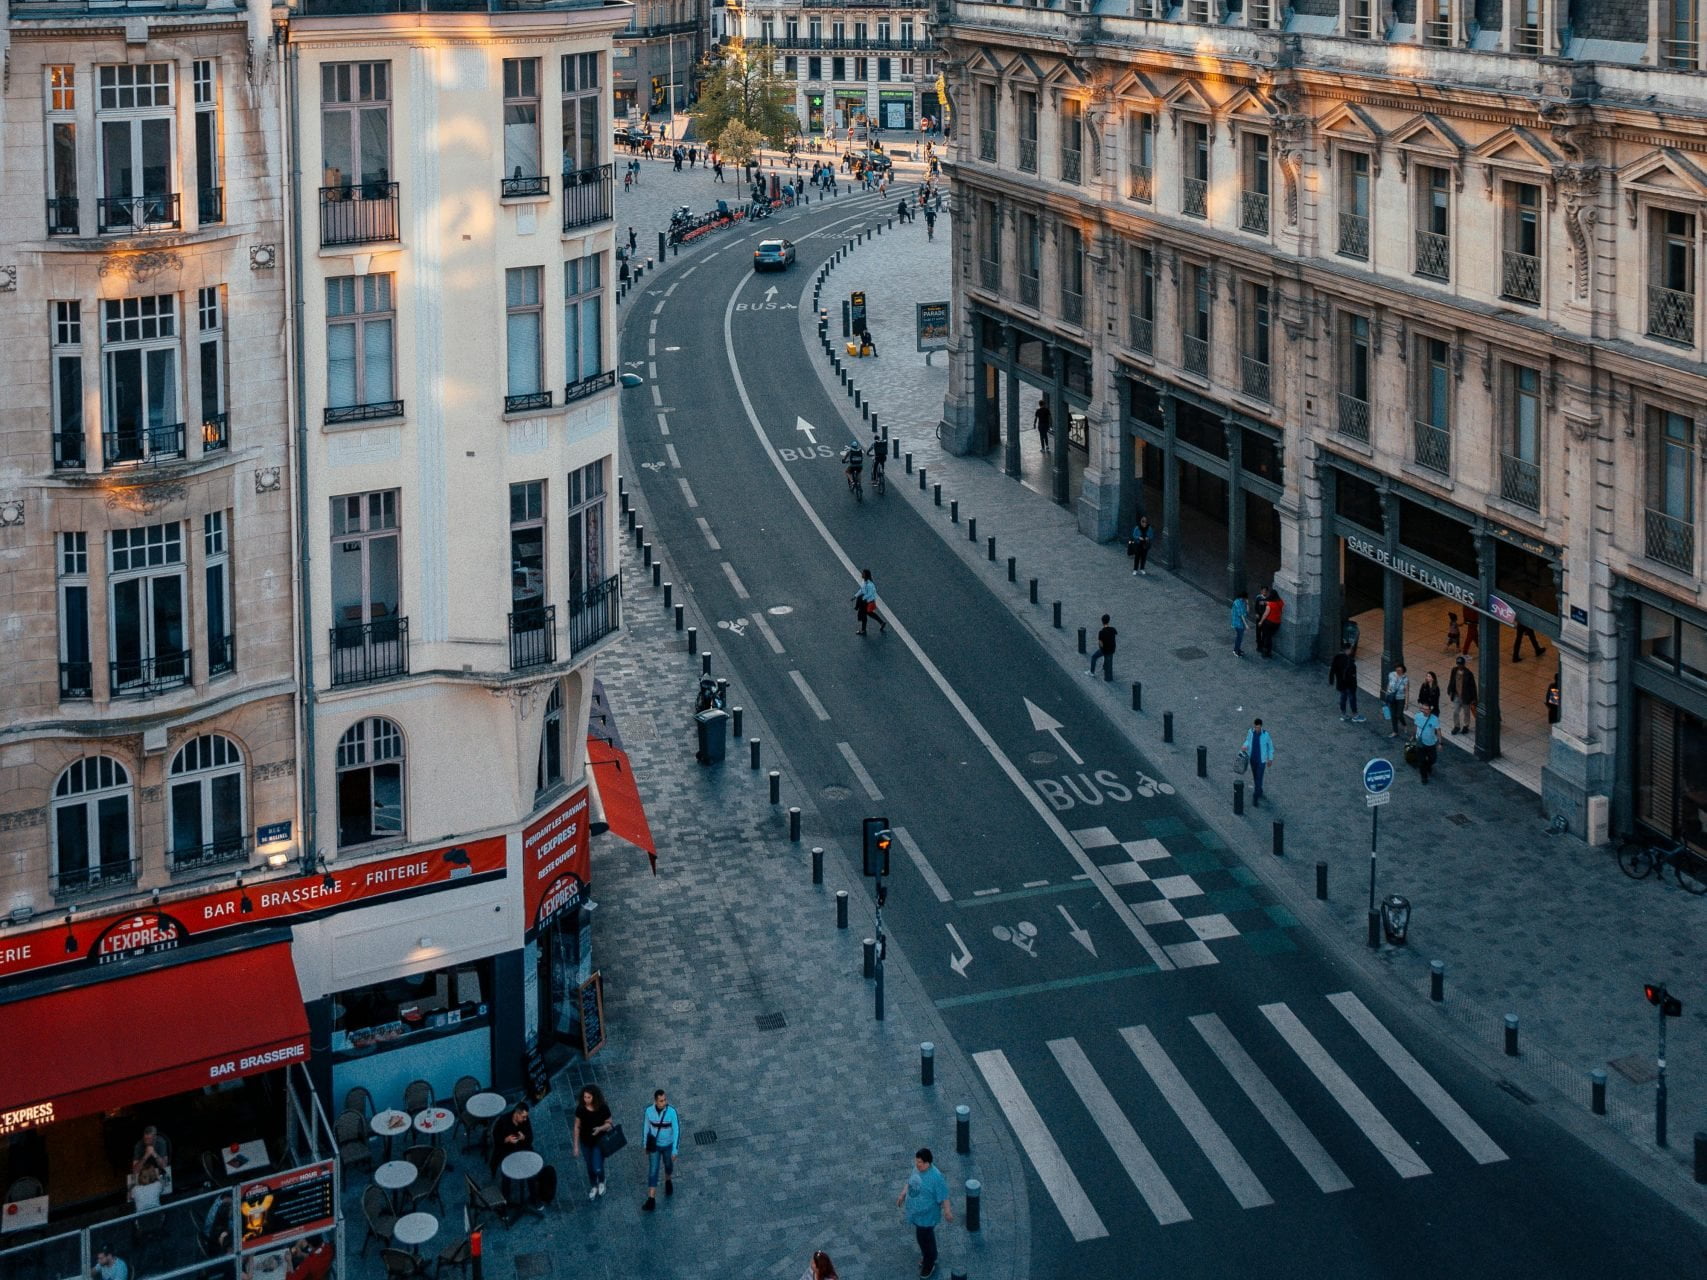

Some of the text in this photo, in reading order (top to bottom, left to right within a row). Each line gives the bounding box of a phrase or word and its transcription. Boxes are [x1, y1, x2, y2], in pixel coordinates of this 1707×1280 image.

[736, 303, 777, 311] BUS
[779, 445, 834, 461] BUS
[1347, 535, 1475, 605] GARE DE LILLE FLANDRES
[1491, 603, 1513, 618] SNCF
[1034, 770, 1133, 811] BUS
[525, 798, 587, 849] PENDANT LES TRAVAUX
[537, 823, 577, 860] L'EXPRESS
[538, 844, 577, 880] RESTE OUVERT
[204, 901, 235, 919] BAR
[366, 862, 429, 886] FRITERIE
[540, 880, 578, 921] L'EXPRESS
[100, 923, 177, 955] L'EXPRESS
[210, 1043, 305, 1077] BAR BRASSERIE
[300, 1171, 318, 1181] HOUR
